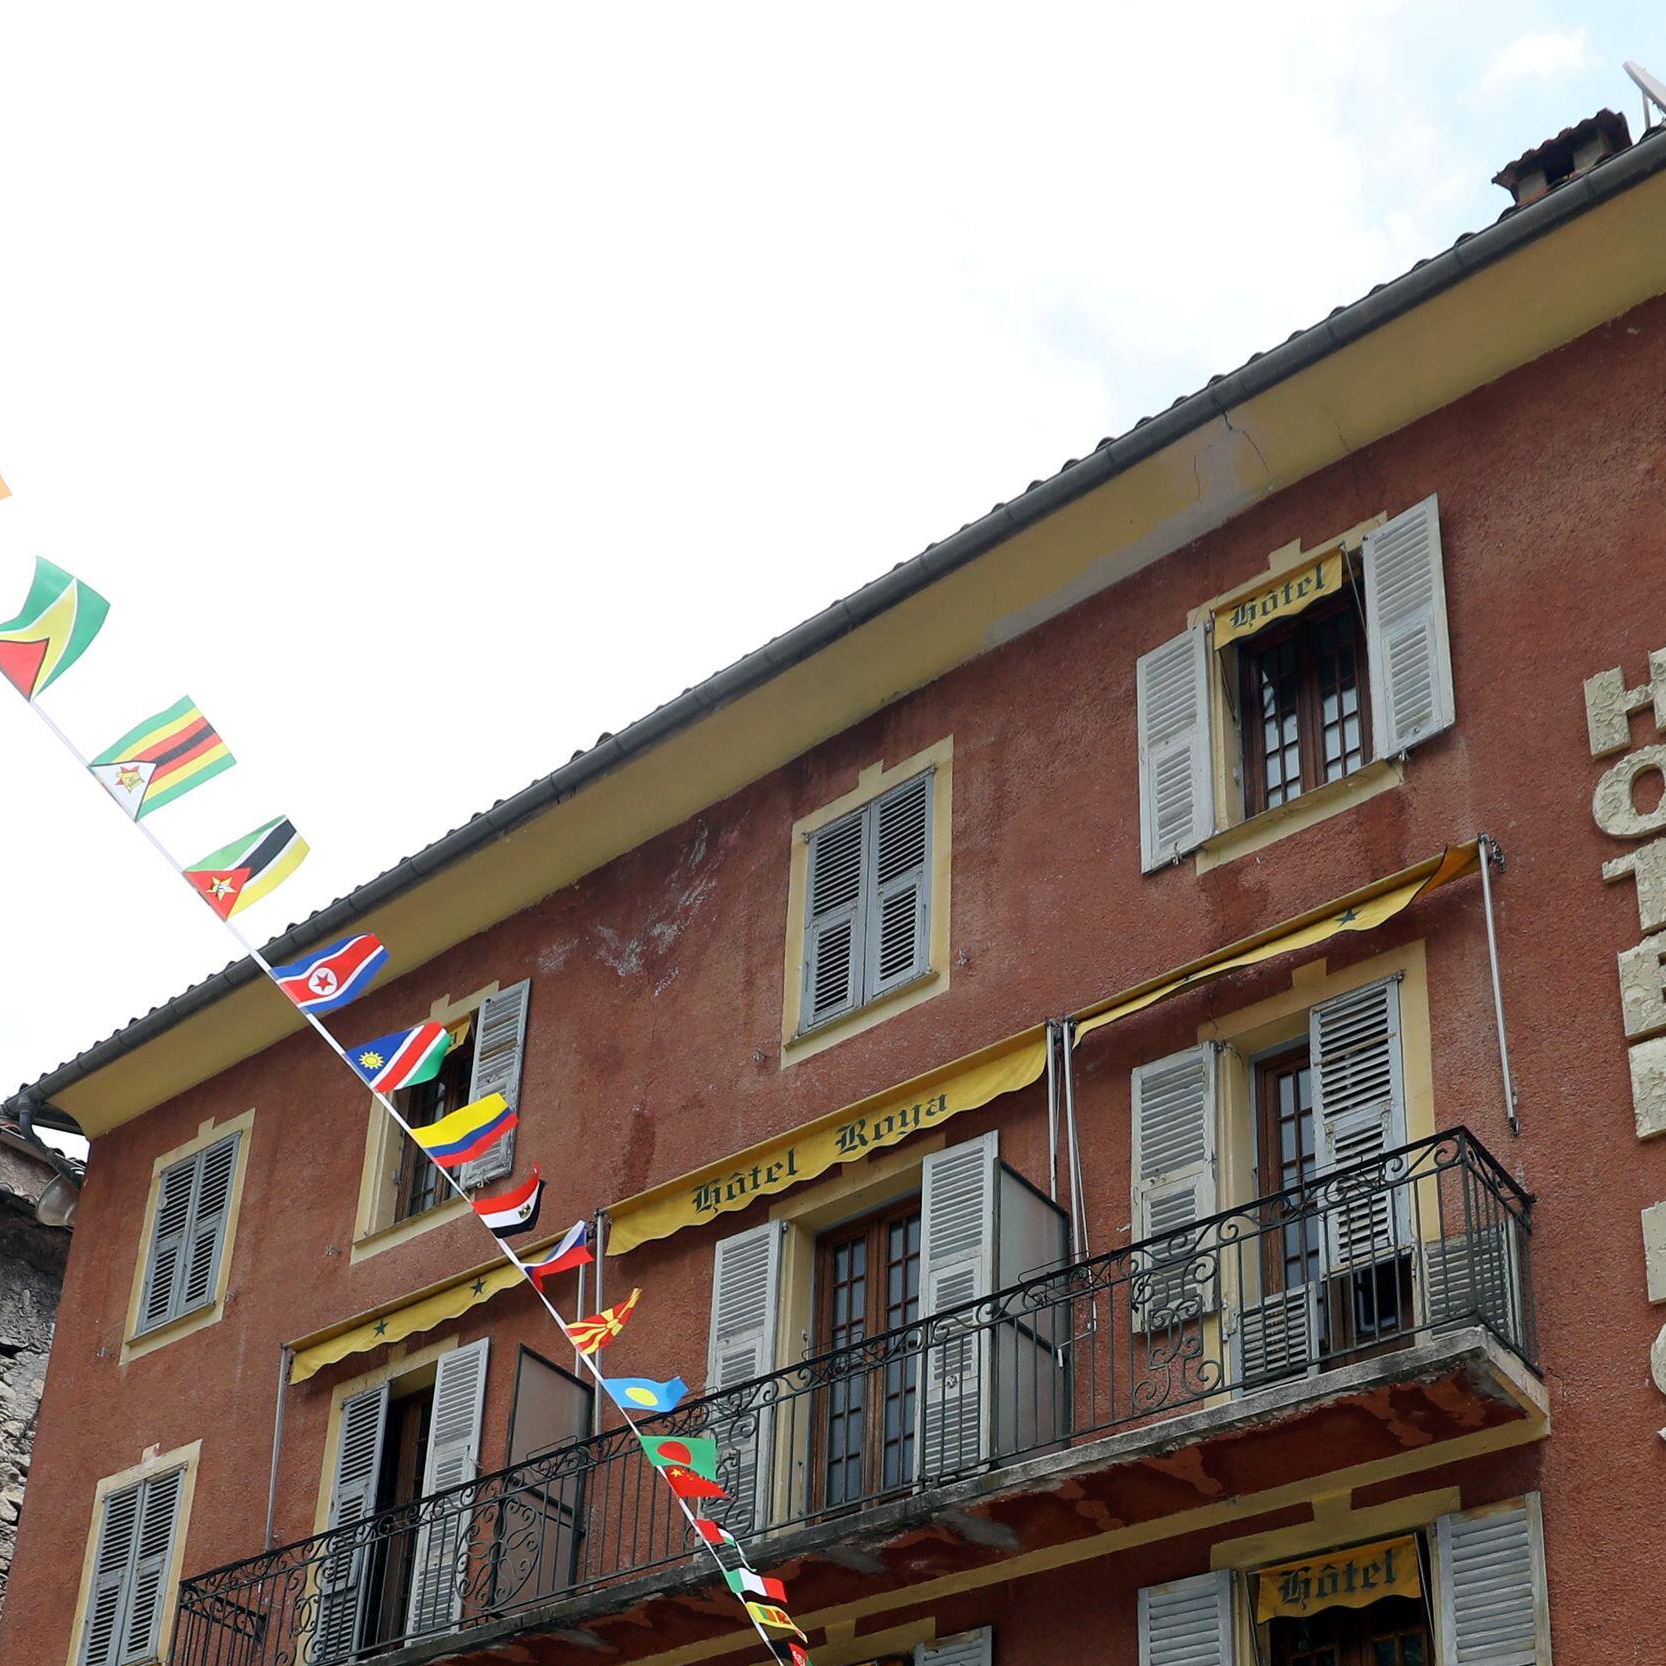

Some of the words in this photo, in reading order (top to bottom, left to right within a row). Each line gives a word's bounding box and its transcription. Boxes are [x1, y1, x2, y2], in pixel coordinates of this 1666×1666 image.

[692, 1147, 800, 1215] Hôtel
[835, 1093, 947, 1155] Roya
[1277, 1548, 1397, 1610] Hôtel
